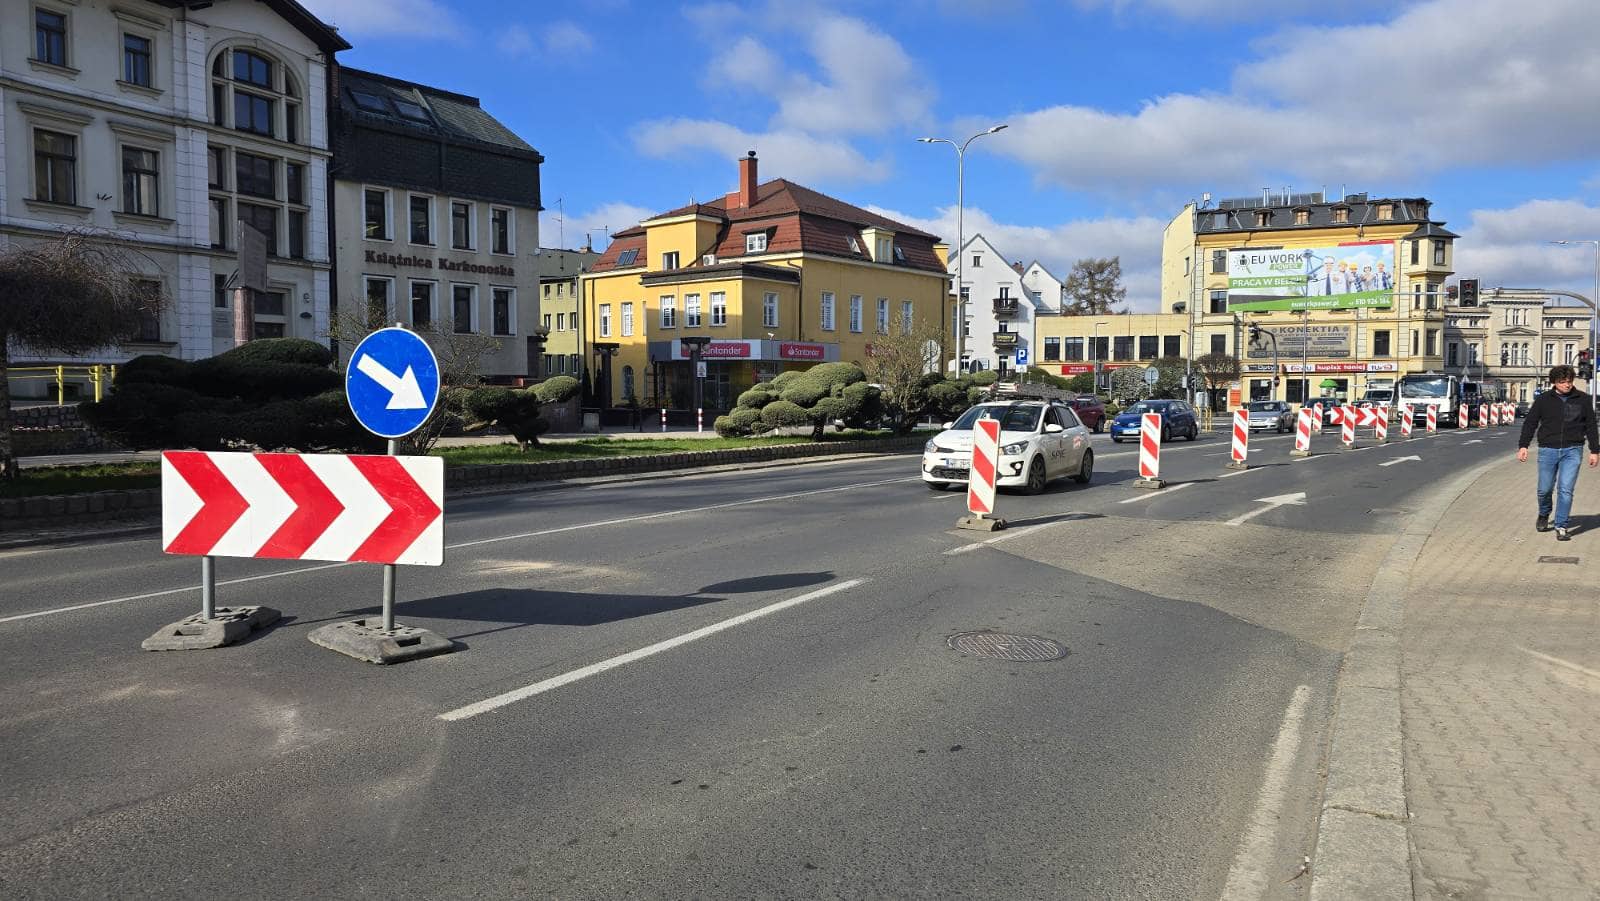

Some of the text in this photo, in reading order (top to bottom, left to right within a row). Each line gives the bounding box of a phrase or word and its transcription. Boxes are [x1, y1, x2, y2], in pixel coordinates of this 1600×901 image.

[1251, 253, 1303, 265] EU WORK
[438, 257, 515, 277] Karkonoska
[1232, 279, 1262, 287] PRACA
[1263, 278, 1273, 286] W
[1279, 325, 1340, 334] KONEKTIA
[700, 345, 742, 355] Santander
[794, 348, 820, 357] Santander
[1018, 350, 1026, 359] P
